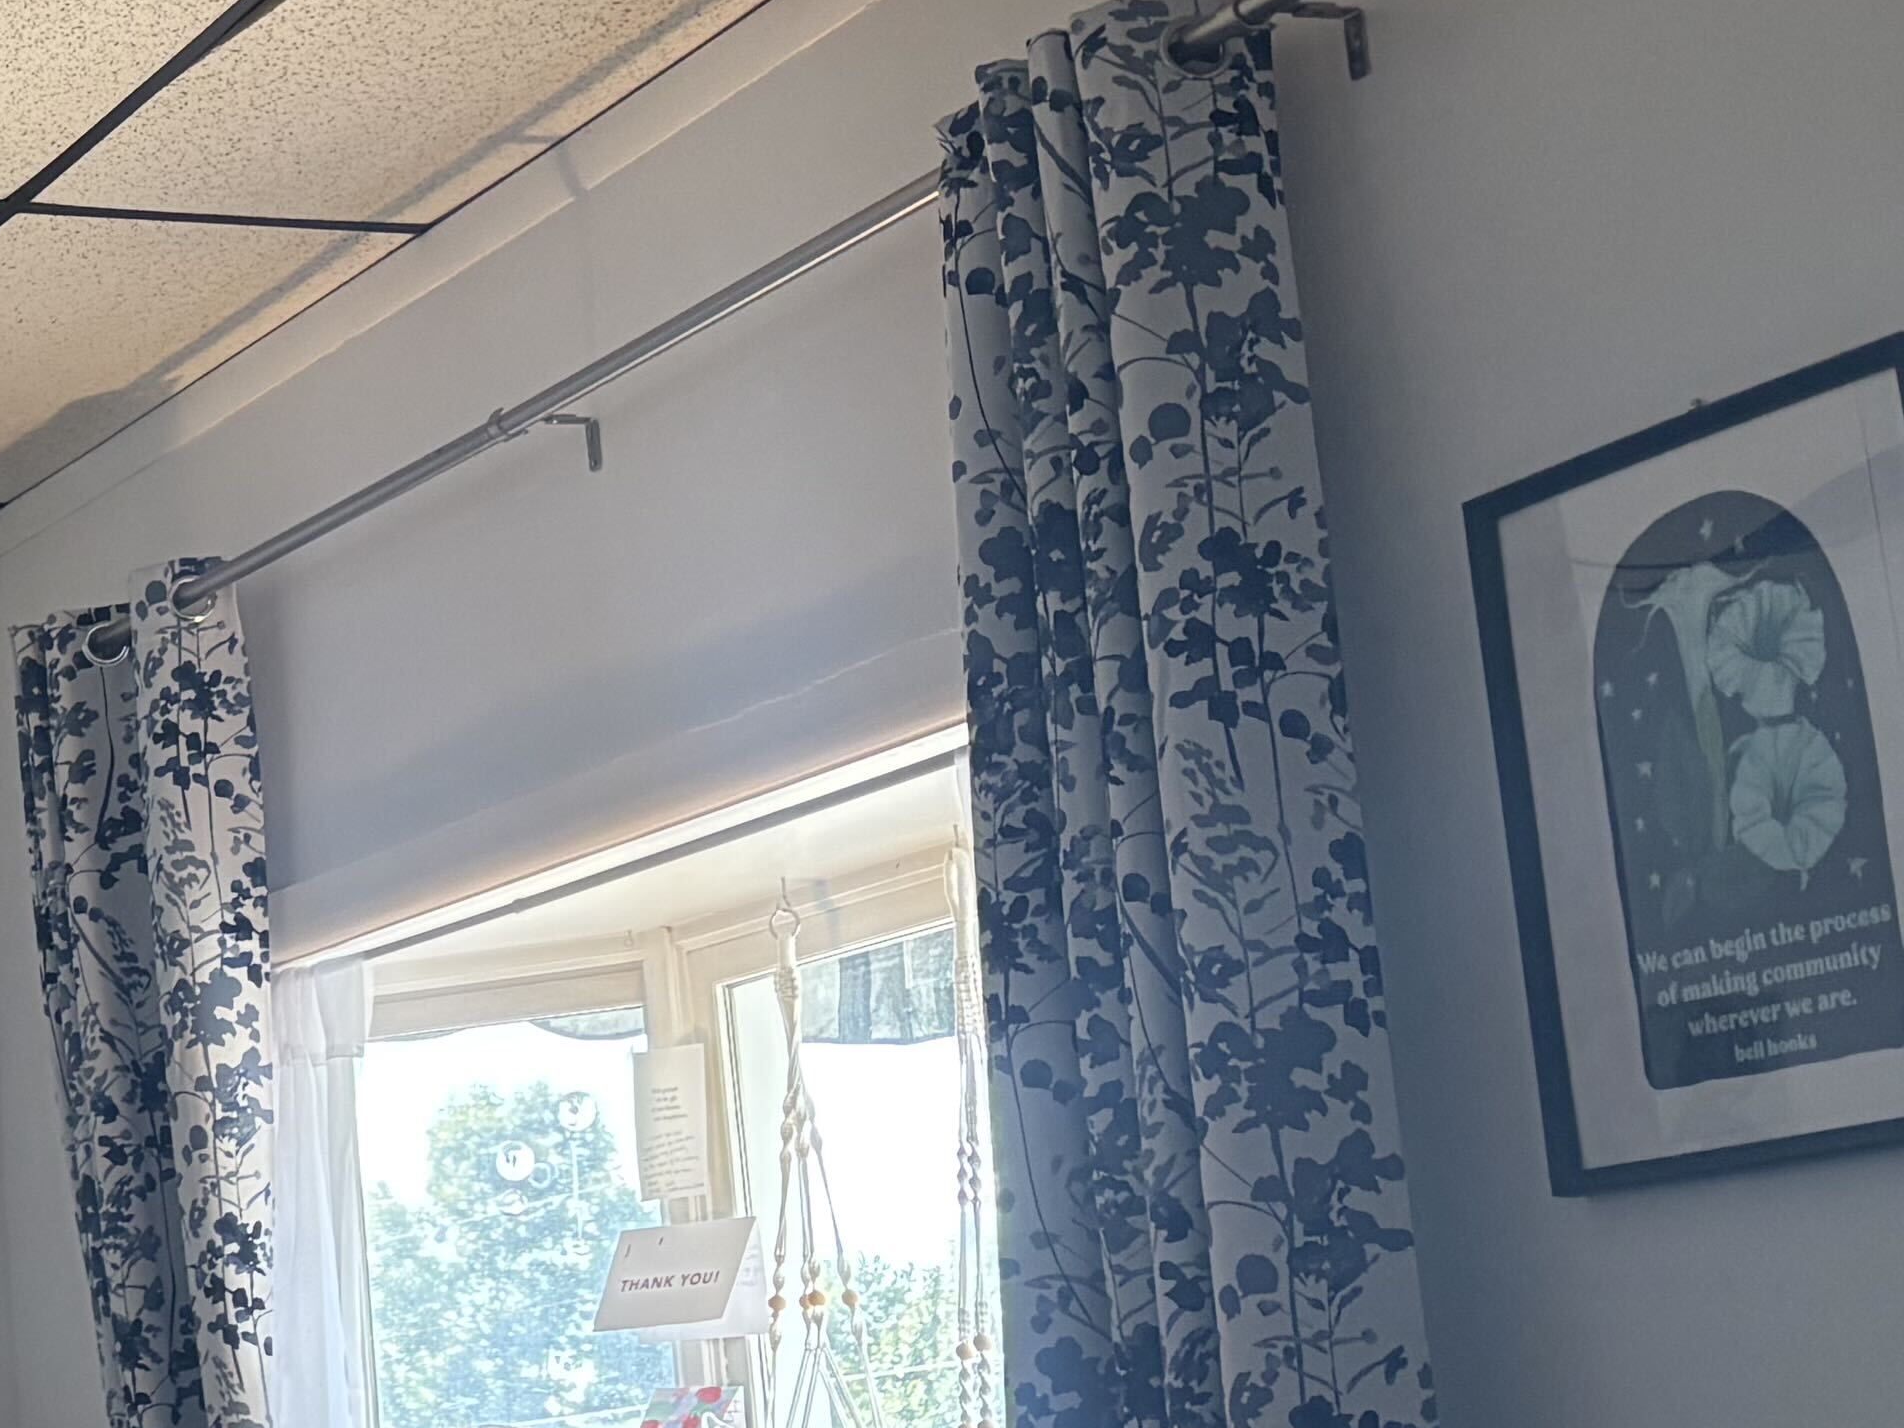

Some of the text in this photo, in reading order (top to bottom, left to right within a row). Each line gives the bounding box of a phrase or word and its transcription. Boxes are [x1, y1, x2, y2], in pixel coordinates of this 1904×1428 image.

[1636, 903, 1892, 975] We can begin the process
[1657, 941, 1883, 1008] of making community
[1688, 987, 1857, 1037] wherever we are.
[1734, 1041, 1766, 1063] bell
[621, 1270, 720, 1293] THANK YOU!
